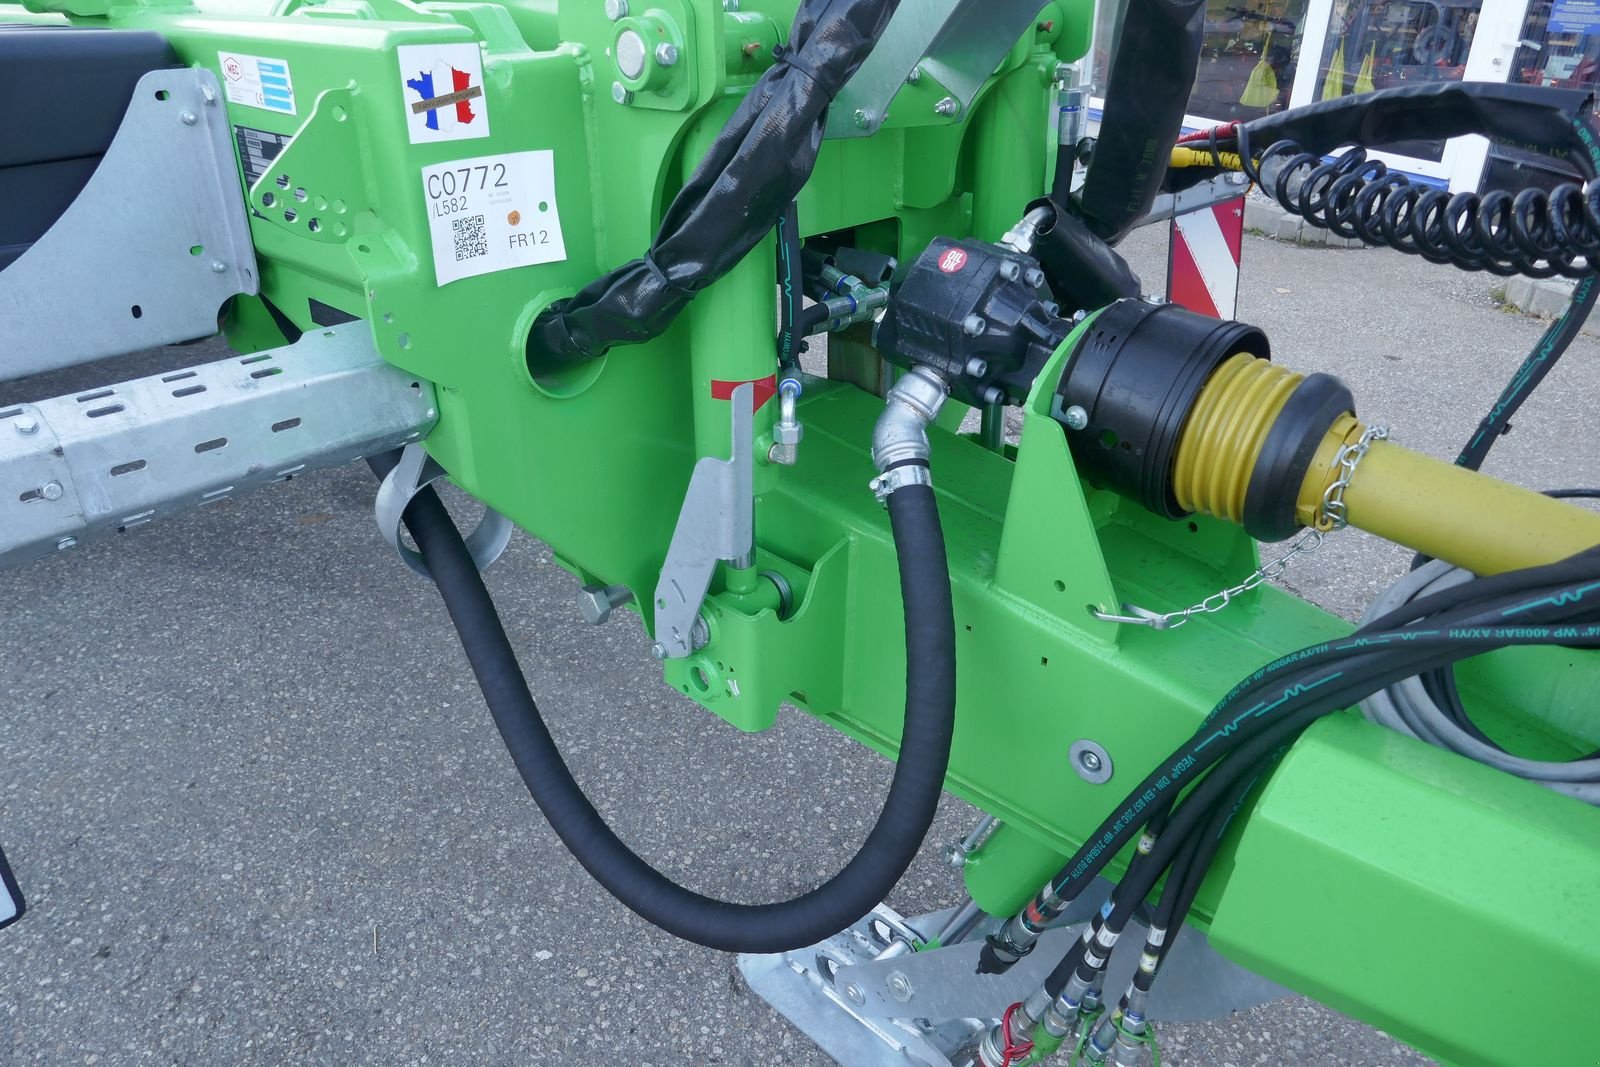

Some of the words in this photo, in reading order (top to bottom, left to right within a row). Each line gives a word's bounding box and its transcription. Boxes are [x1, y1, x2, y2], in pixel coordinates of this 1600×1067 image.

[508, 230, 550, 248] FR12
[947, 250, 964, 264] OIL
[942, 260, 958, 272] OK
[1450, 628, 1490, 638] AX/YH
[1496, 628, 1550, 638] 400BAR
[1554, 626, 1578, 638] WP
[1253, 668, 1266, 681] WP
[1266, 653, 1299, 673] 400BAR
[1300, 644, 1328, 659] AX/YH
[1155, 775, 1171, 791] DIN
[1142, 790, 1156, 803] EN
[1104, 831, 1115, 844] WP
